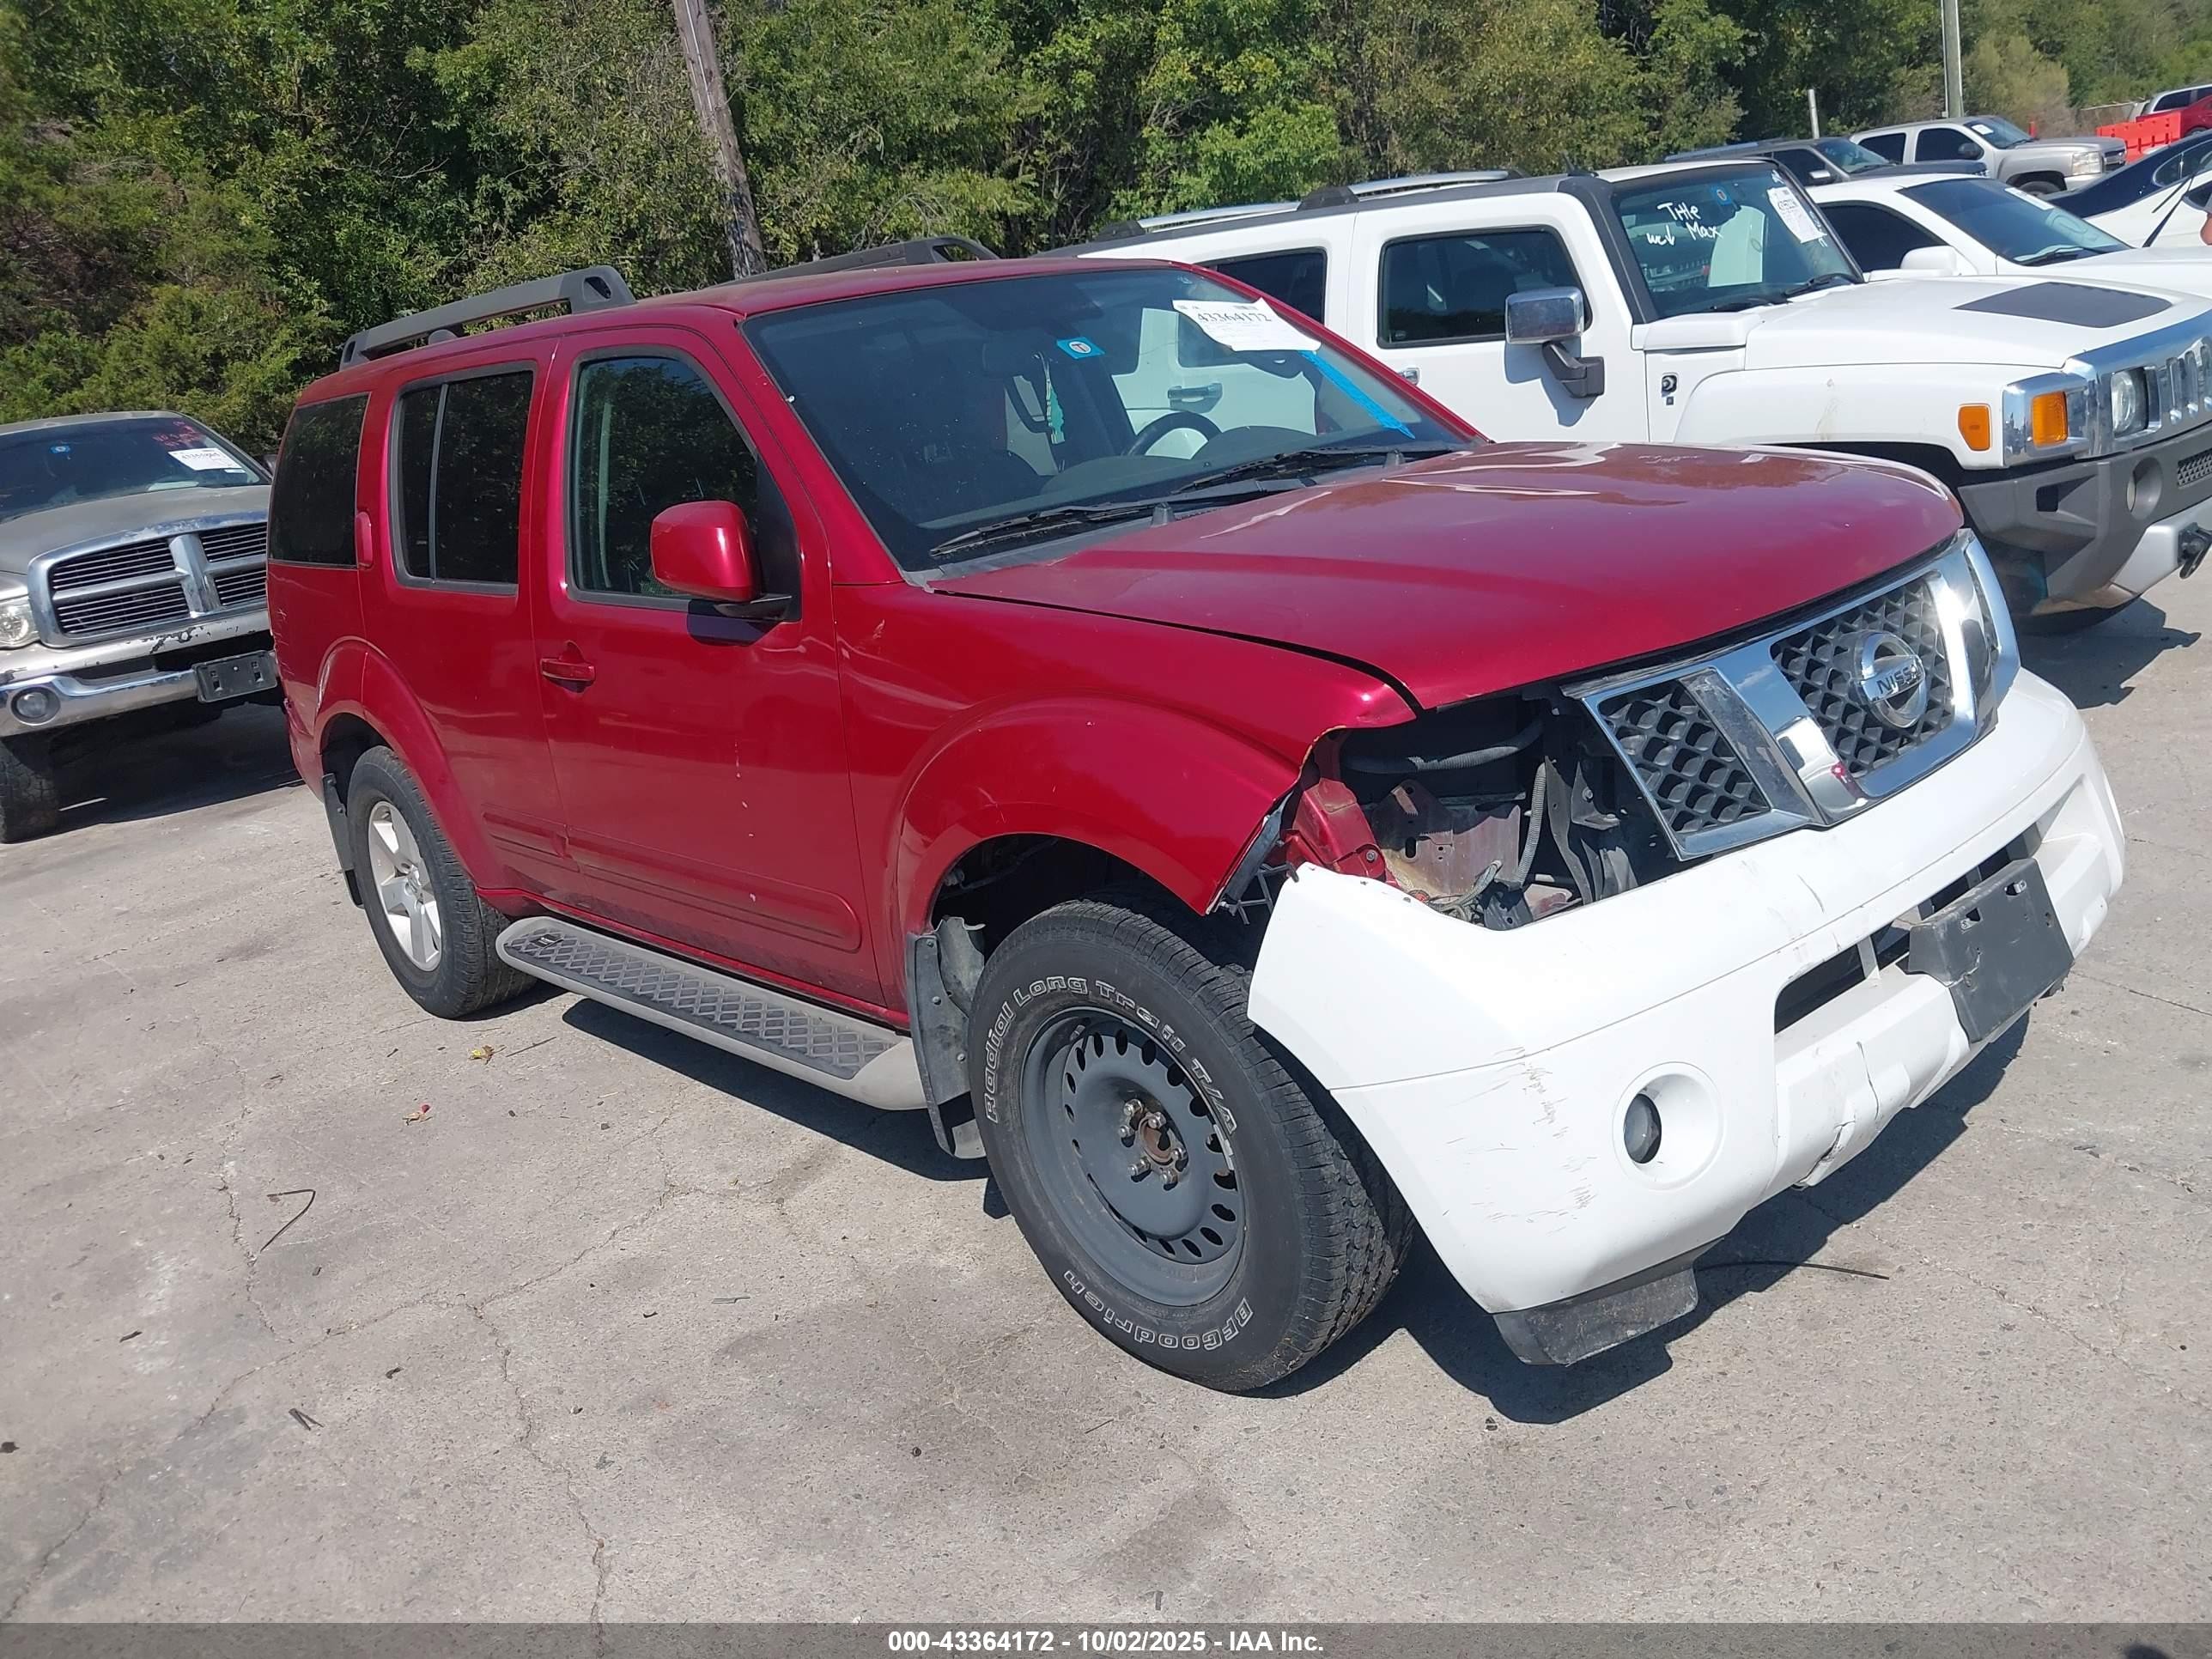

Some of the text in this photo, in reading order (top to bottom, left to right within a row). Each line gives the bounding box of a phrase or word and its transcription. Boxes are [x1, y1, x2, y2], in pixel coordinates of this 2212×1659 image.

[1685, 222, 1723, 240] Max
[1197, 312, 1272, 323] 43364172
[984, 1000, 1017, 1124] Radial
[1012, 975, 1089, 1007] Long
[1191, 1057, 1237, 1135] T/A
[1063, 1269, 1255, 1351] BFGoodrich
